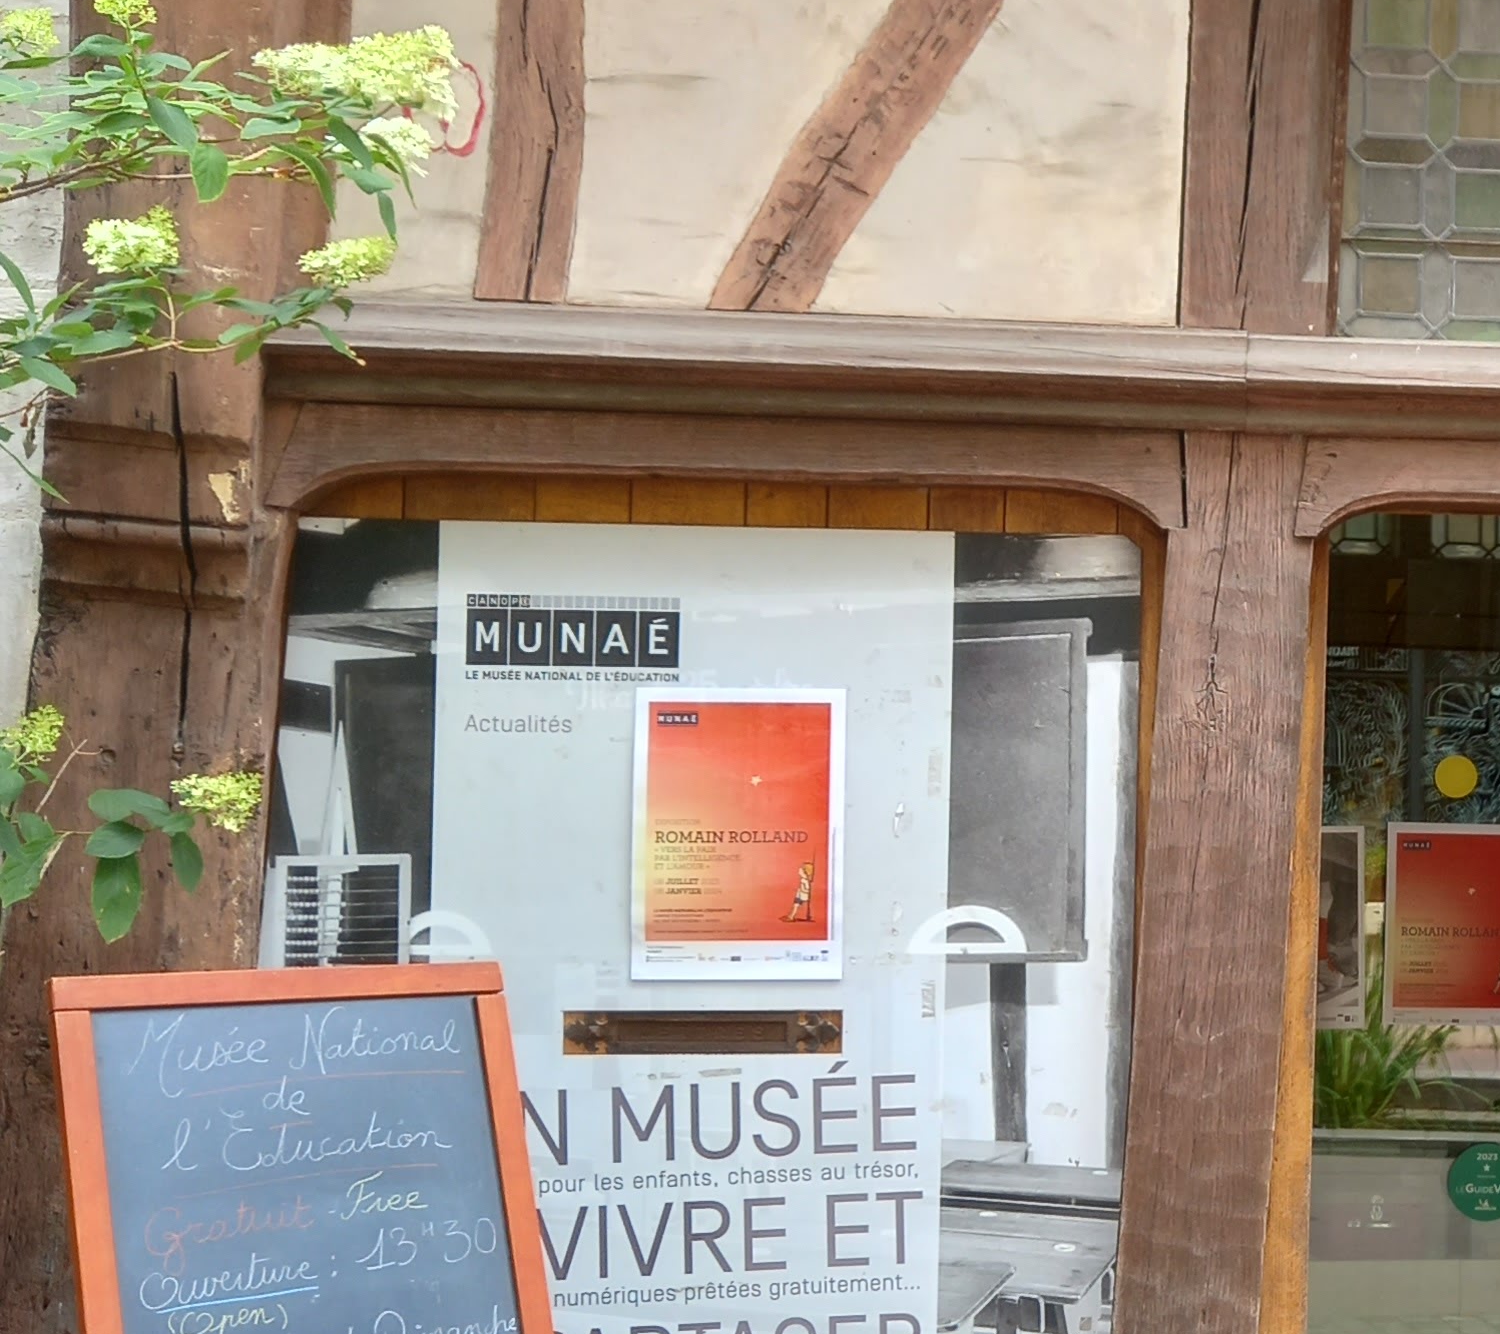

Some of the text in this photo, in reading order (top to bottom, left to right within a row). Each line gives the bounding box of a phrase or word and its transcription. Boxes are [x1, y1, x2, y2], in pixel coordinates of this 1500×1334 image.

[475, 618, 669, 655] MUNAÉ
[466, 670, 679, 682] LE MUSÉE NATIONAL DE L'ÉDUCATION
[464, 714, 573, 733] Actualités
[654, 831, 809, 843] ROMAIN ROLLAND
[1401, 926, 1450, 937] ROMAIN
[128, 1006, 460, 1098] Musée National
[263, 1075, 310, 1115] de
[611, 1060, 918, 1164] MUSÉE
[1477, 1152, 1498, 1161] 2023
[538, 1163, 920, 1198] pour les enfants, chasses au trésor,
[144, 1196, 315, 1275] Gratuit
[341, 1170, 428, 1219] Free
[536, 1191, 924, 1281] VIVRE ET
[139, 1252, 319, 1311] Ouverture
[553, 1274, 921, 1307] numériques prêtées gratuitement...
